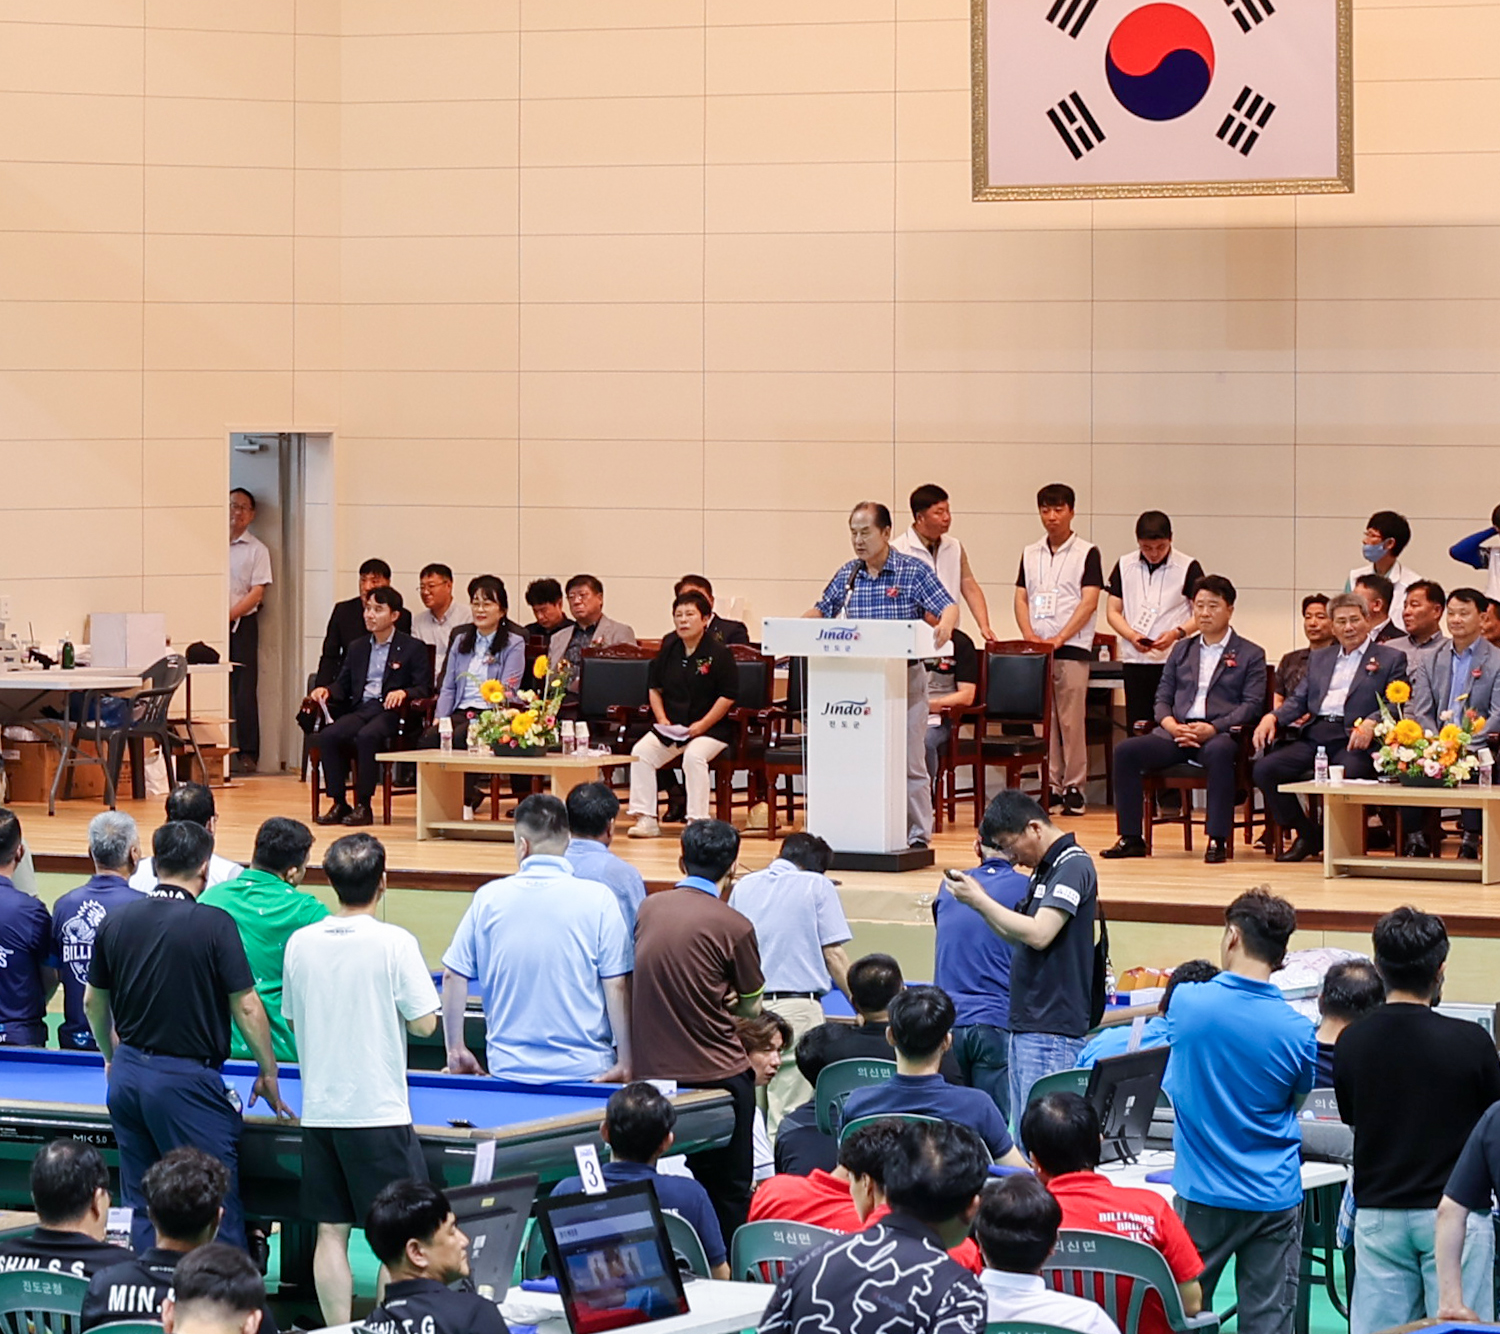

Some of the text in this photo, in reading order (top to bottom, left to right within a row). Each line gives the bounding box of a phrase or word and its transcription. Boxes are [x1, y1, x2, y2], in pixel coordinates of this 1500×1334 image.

[821, 701, 863, 717] Jindo
[857, 1066, 892, 1079] 의신면
[1313, 1098, 1338, 1110] 의신
[584, 1160, 599, 1188] 3
[772, 1230, 812, 1245] 의신면
